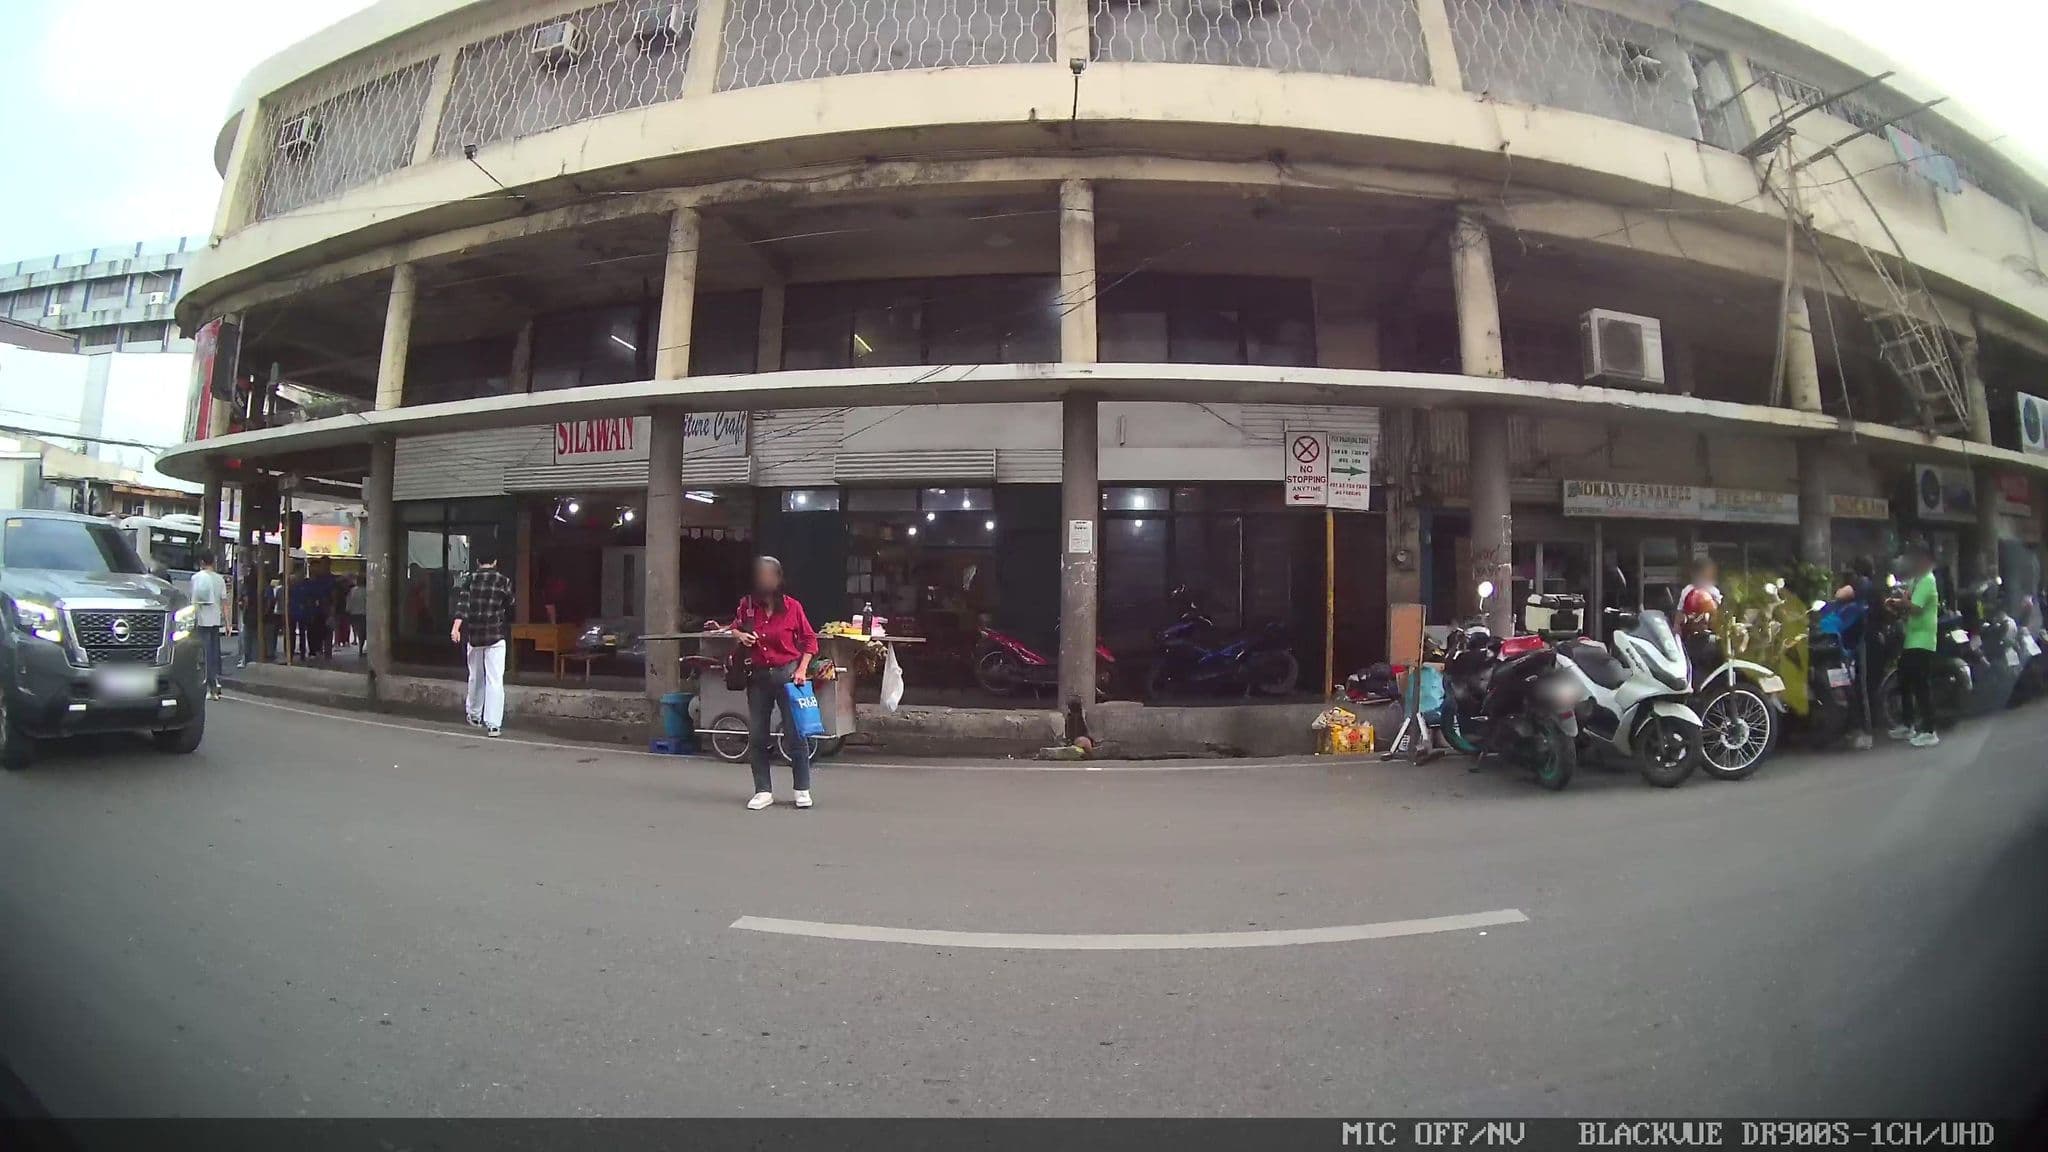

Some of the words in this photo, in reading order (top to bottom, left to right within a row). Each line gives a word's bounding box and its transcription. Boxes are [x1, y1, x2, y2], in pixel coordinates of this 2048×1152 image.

[558, 417, 634, 454] SILAWAN
[713, 411, 747, 445] Craft
[1287, 476, 1326, 484] STOPPING
